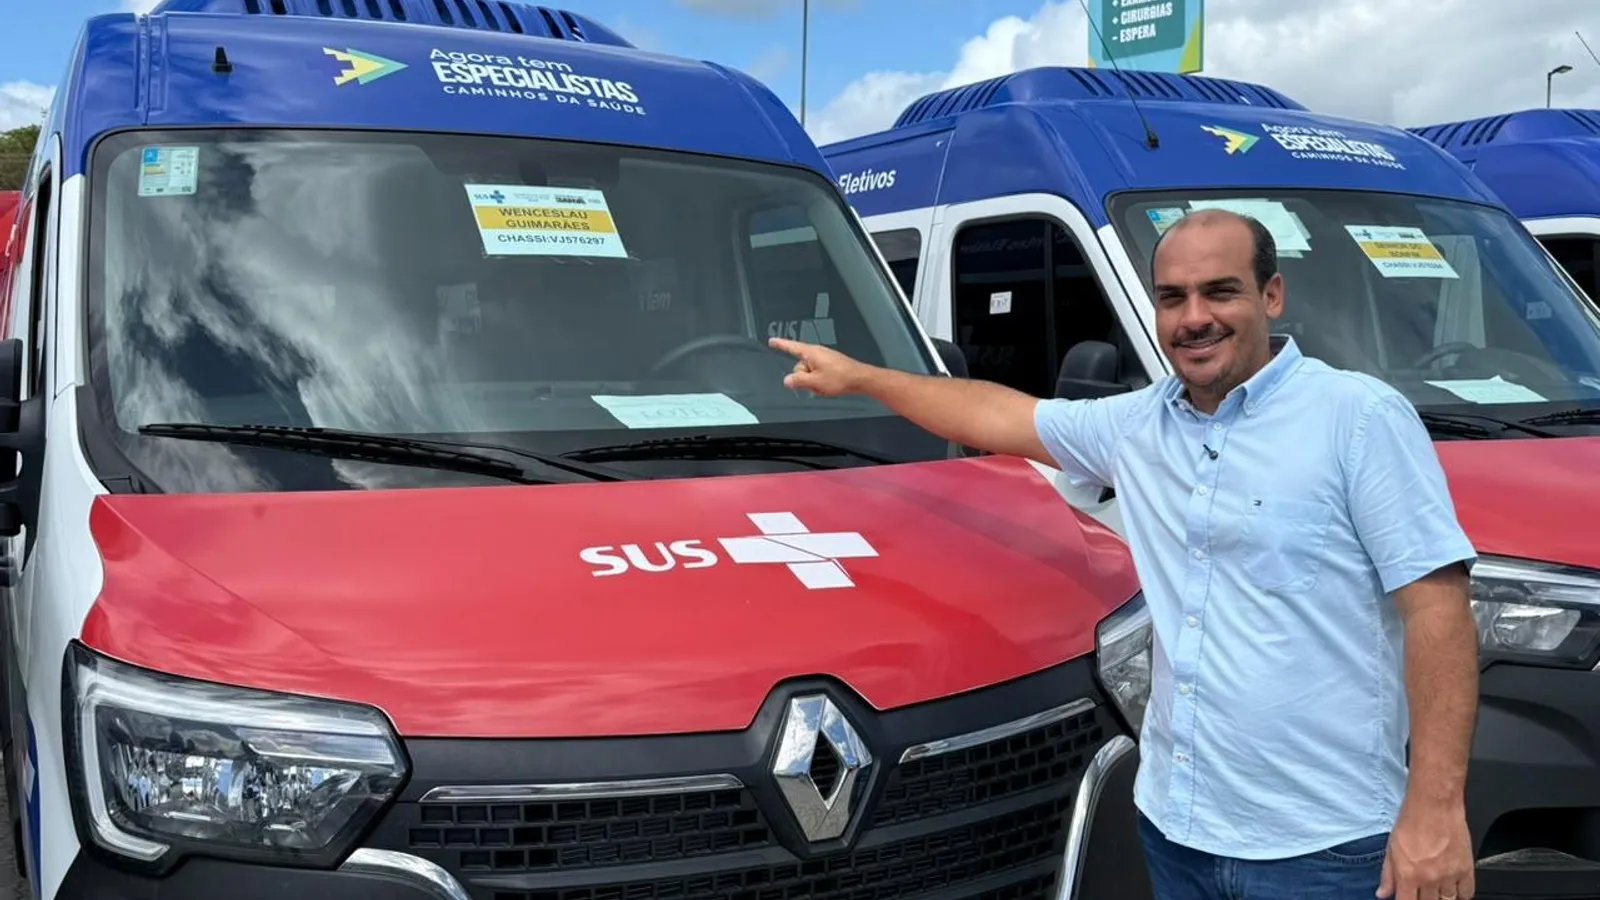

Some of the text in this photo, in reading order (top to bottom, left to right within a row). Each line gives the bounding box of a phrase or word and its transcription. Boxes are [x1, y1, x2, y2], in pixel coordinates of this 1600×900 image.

[1120, 2, 1173, 25] CIRURGIAS
[1120, 23, 1157, 43] ESPERA
[430, 48, 573, 73] Agora tem
[431, 61, 639, 103] ESPECIALISTAS
[443, 85, 646, 115] CAMINHOS DA SAÚDE
[1270, 133, 1396, 161] ESPECIALISTAS
[1291, 151, 1353, 162] CAMINHOS
[499, 207, 588, 219] WENCESLAU
[580, 539, 718, 577] SUS
